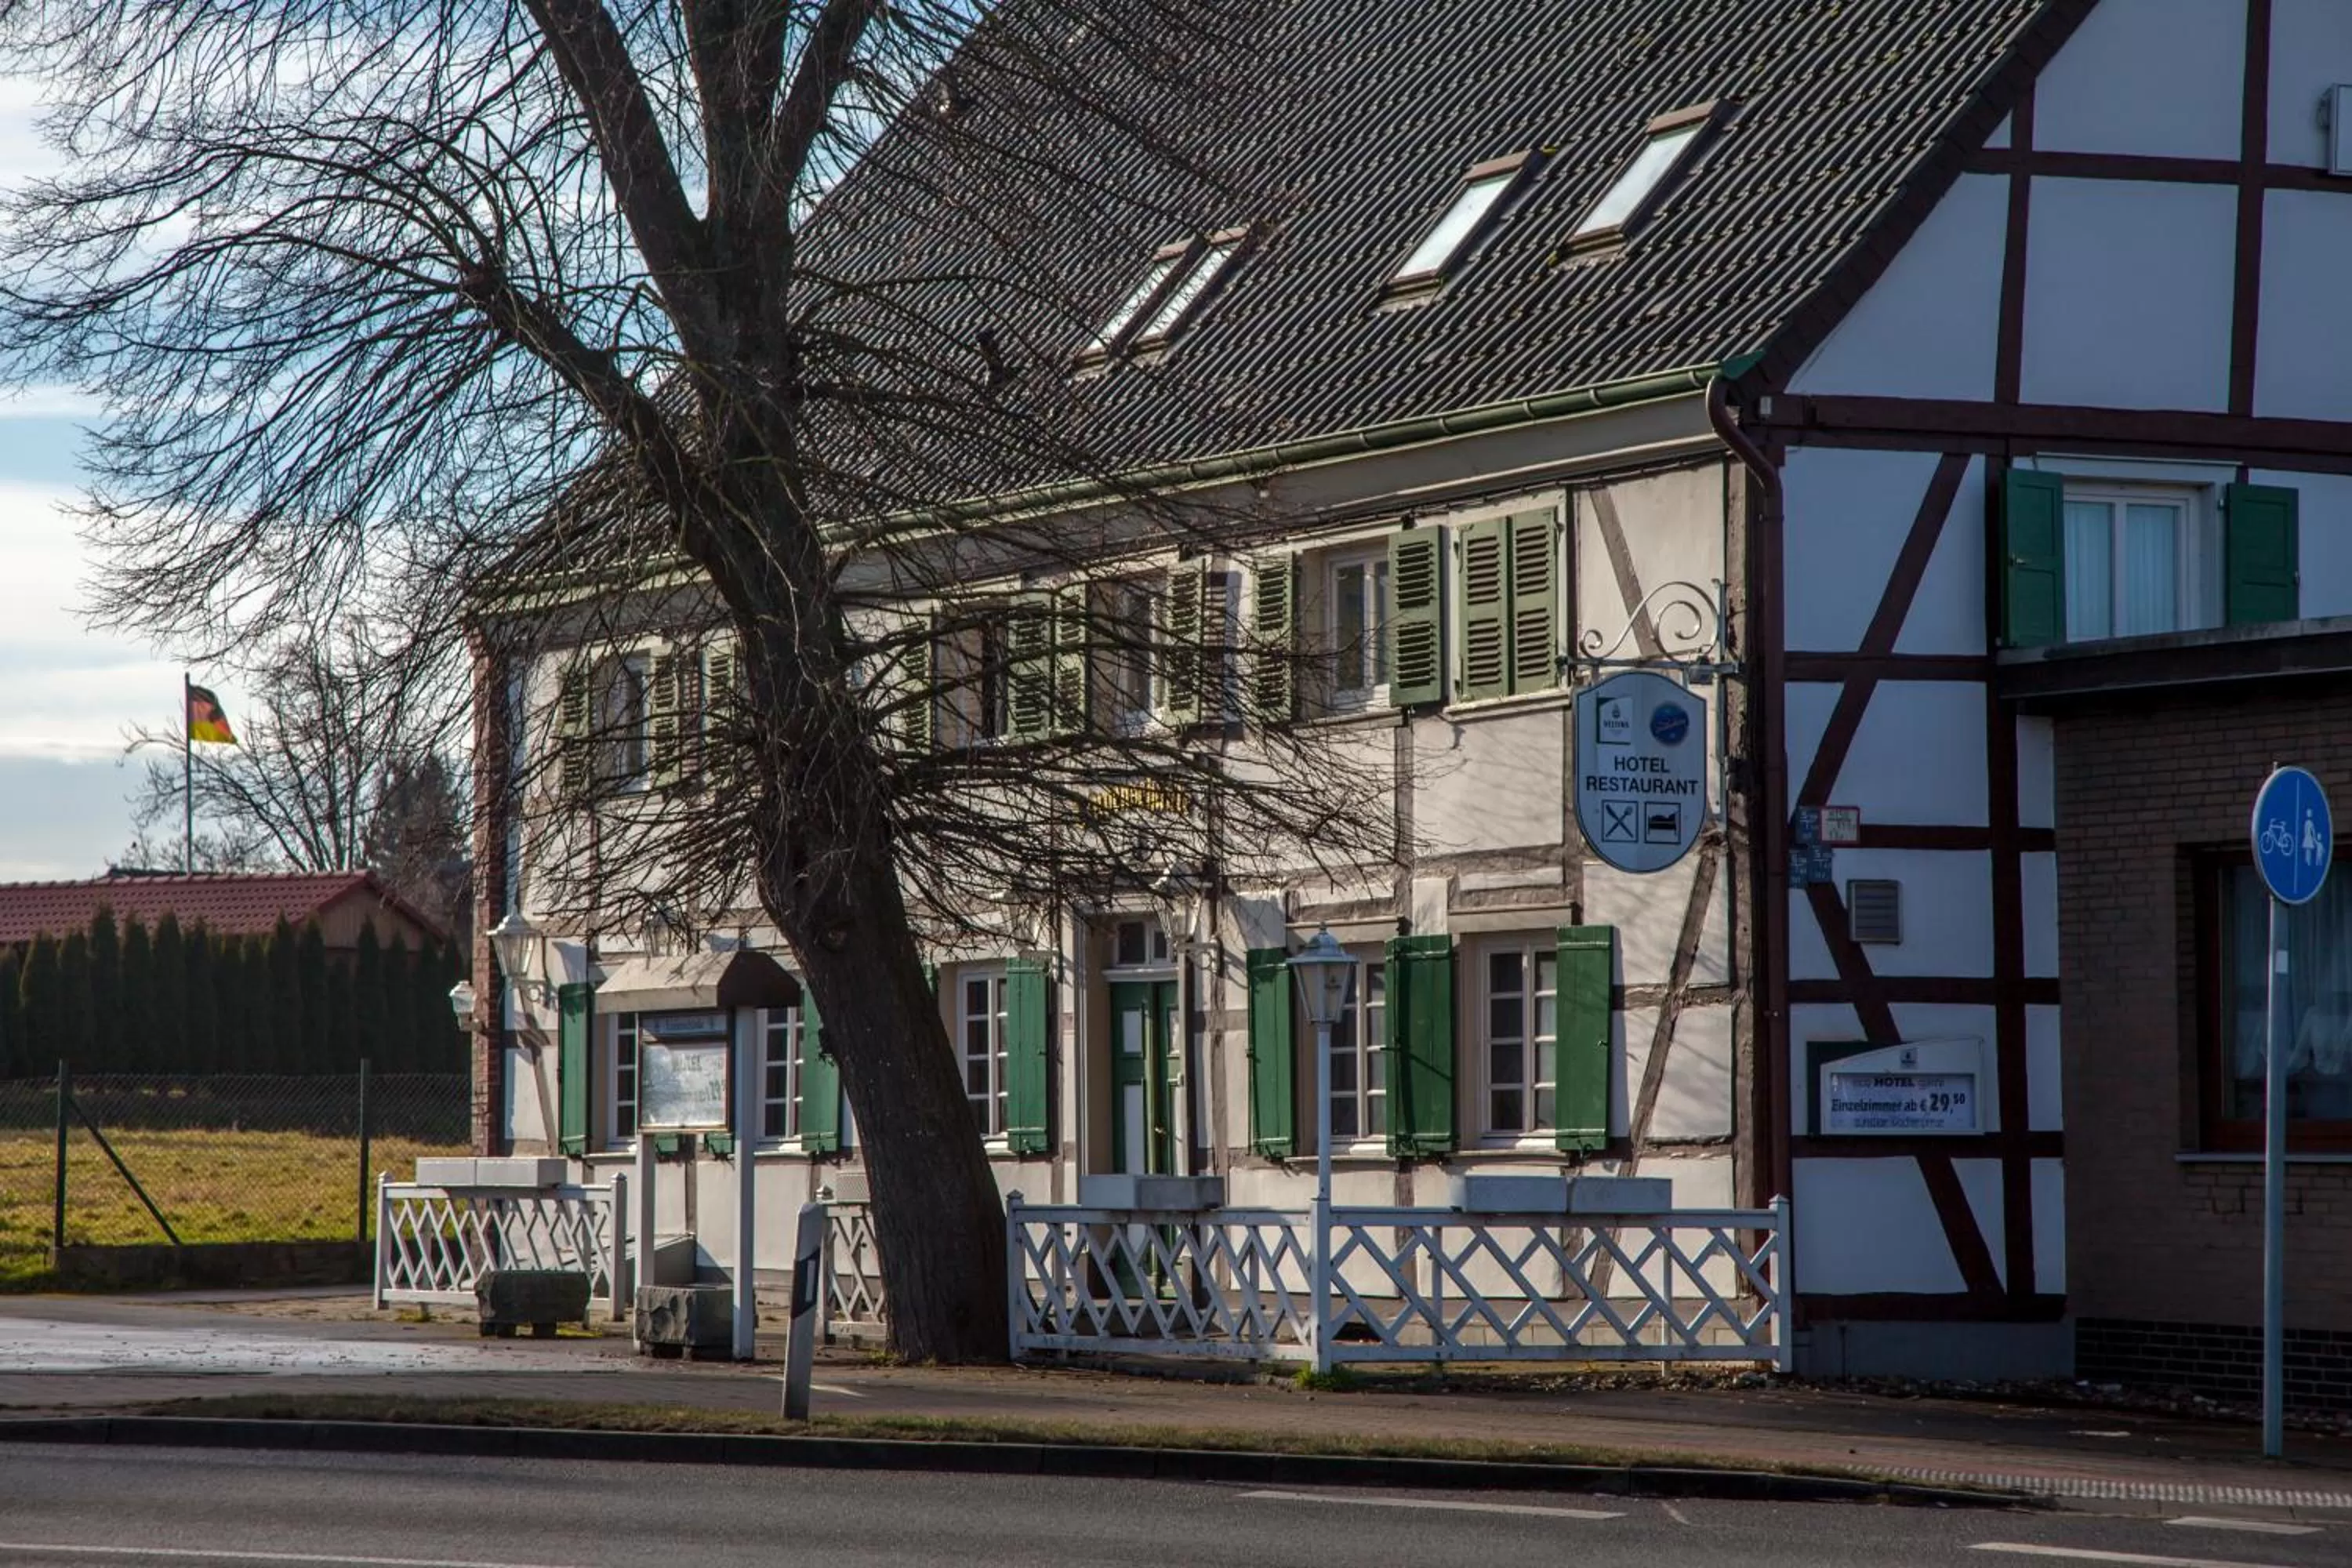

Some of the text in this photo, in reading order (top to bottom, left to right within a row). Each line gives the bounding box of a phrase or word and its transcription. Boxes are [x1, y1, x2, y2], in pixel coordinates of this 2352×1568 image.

[1613, 756, 1670, 773] HOTEL
[1586, 775, 1698, 795] RESTAURANT
[1874, 1078, 1915, 1087] HOTEL
[1831, 1098, 1902, 1112] Einzelzimmer
[1904, 1099, 1918, 1111] ab
